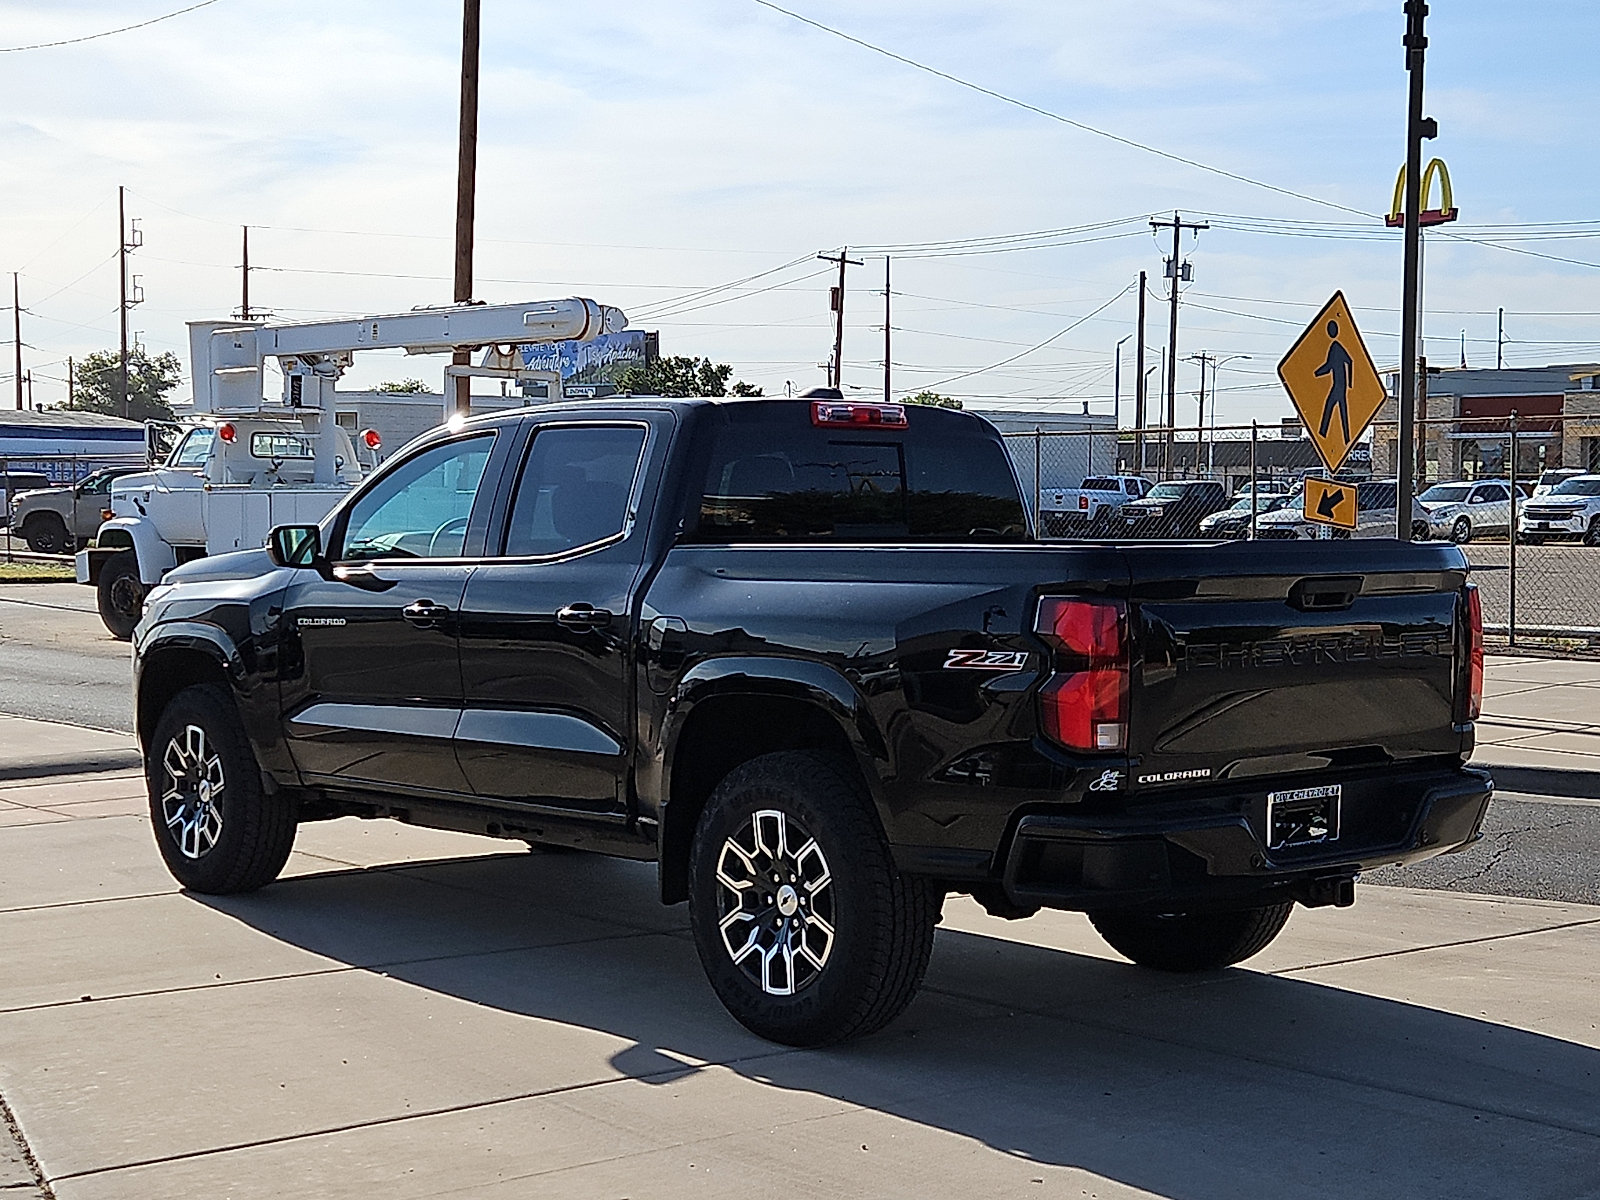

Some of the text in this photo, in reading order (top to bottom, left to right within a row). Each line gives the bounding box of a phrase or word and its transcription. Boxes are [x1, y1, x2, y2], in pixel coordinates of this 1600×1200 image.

[297, 618, 346, 626] COLORADO
[1137, 768, 1211, 784] COLORADO
[1293, 786, 1339, 800] CHEVROLET
